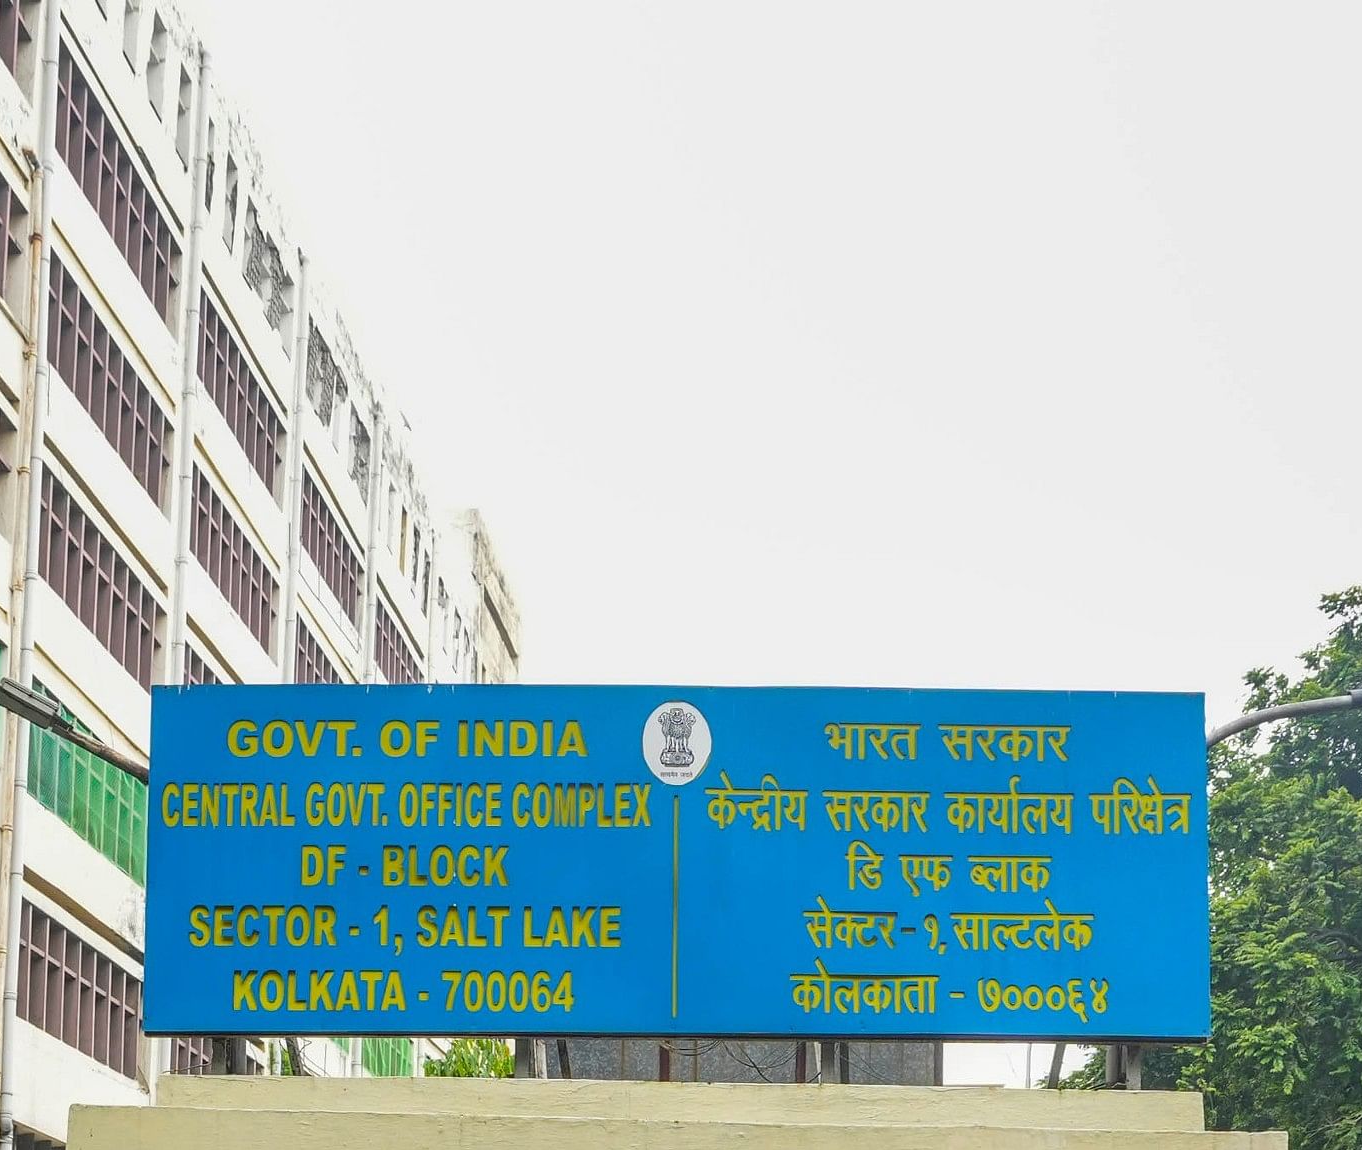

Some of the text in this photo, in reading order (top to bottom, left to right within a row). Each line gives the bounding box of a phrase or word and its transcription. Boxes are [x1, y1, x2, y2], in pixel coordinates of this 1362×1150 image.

[227, 719, 588, 757] GOVT. OF INDIA
[824, 723, 1071, 762] भारत सरकार
[161, 782, 651, 828] CENTRAL GOVT. OFFICE COMPLEX
[704, 771, 1193, 835] केन्द्रीय सरकार कार्यालय परिक्षेत्र
[300, 845, 347, 887] DF
[382, 845, 509, 888] BLOCK
[845, 840, 1052, 897] डि एफ ब्लाक
[189, 905, 337, 947] SECTOR
[373, 906, 404, 956] 1,
[416, 906, 511, 948] SALT
[523, 906, 622, 948] LAKE
[232, 969, 407, 1012] KOLKATA
[441, 971, 575, 1013] 700064
[790, 957, 940, 1014] कोलकाता
[977, 977, 1110, 1023] ७०००६४
